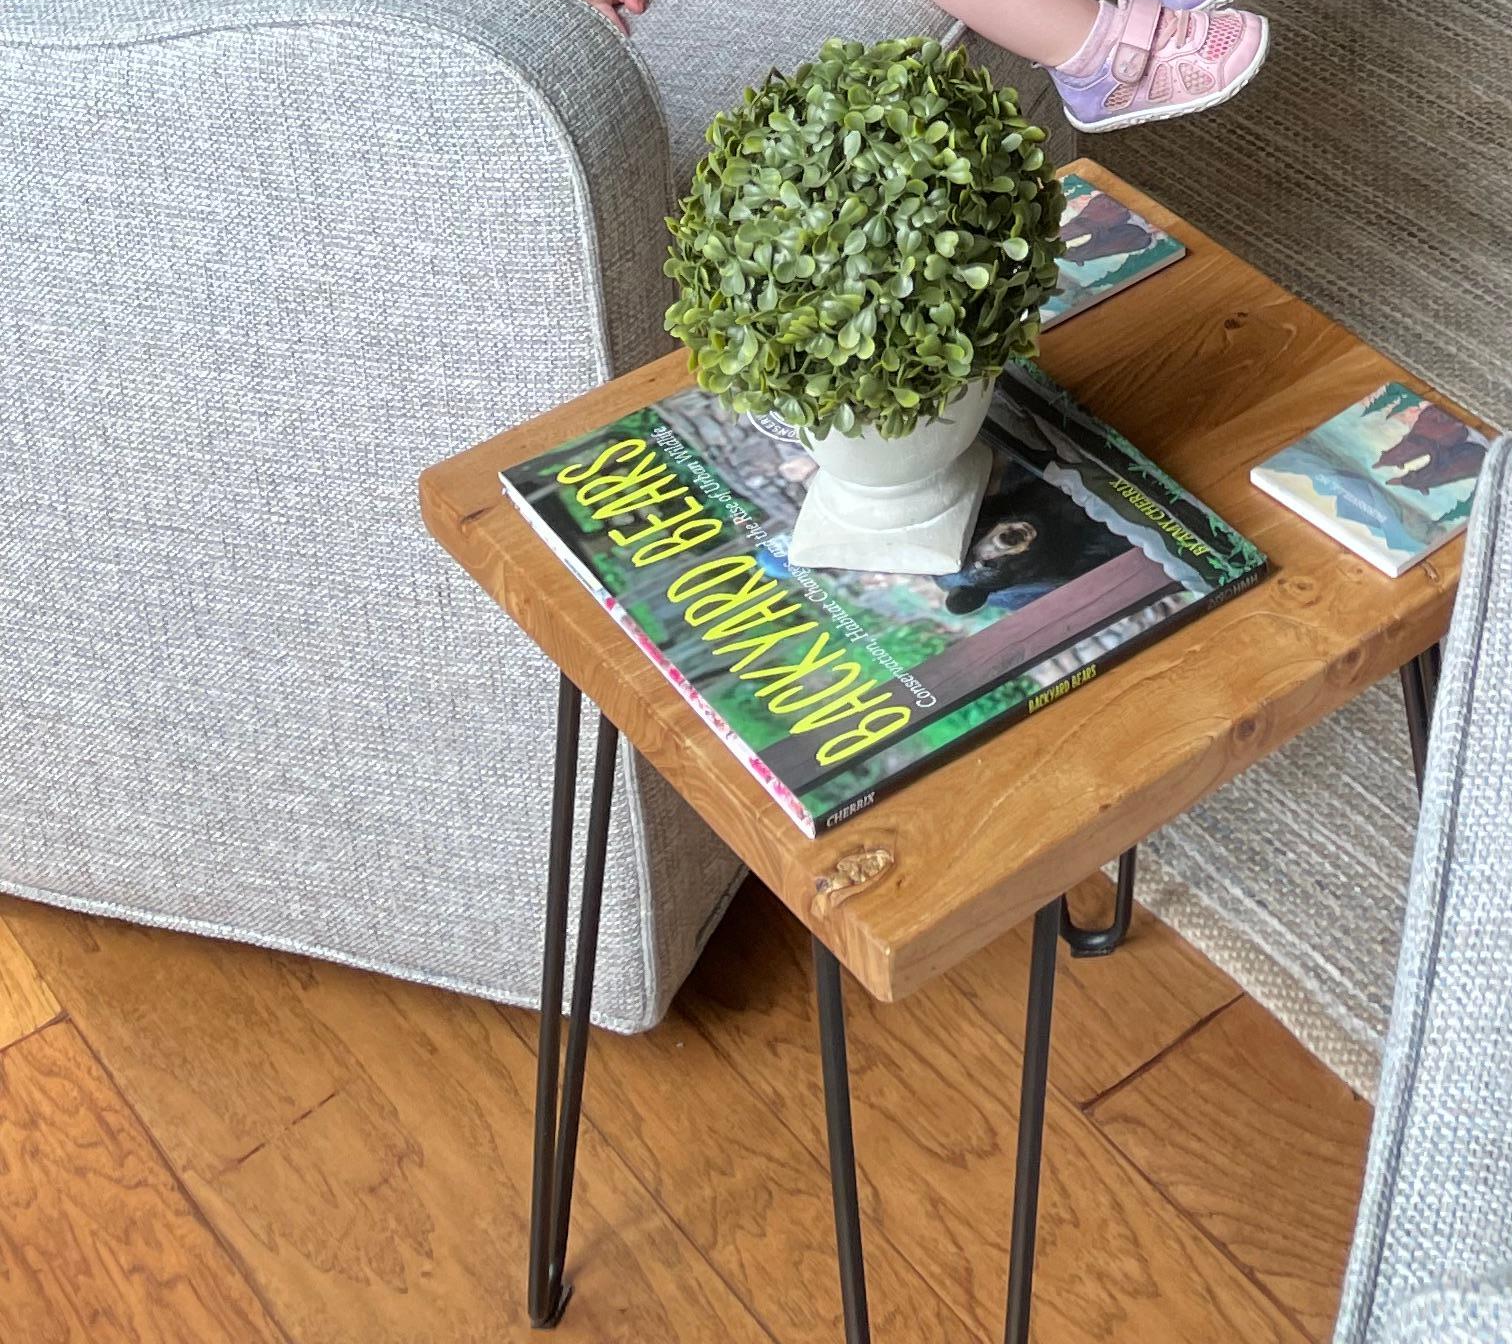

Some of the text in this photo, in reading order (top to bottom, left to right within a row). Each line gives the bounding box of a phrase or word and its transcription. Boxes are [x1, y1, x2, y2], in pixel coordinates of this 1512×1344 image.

[650, 425, 690, 464] Wildlife
[687, 461, 719, 500] Urban
[716, 489, 732, 503] of
[728, 502, 749, 526] Rise
[746, 519, 767, 543] the
[1108, 479, 1209, 556] BY AMY CHERRIX
[756, 539, 787, 558] and
[556, 438, 911, 765] BACKYARD BEARS
[823, 600, 869, 644] Habitat
[865, 639, 937, 708] Conservation,
[1028, 663, 1097, 714] BACKYARD BEARS
[826, 791, 875, 827] CHERRIX
